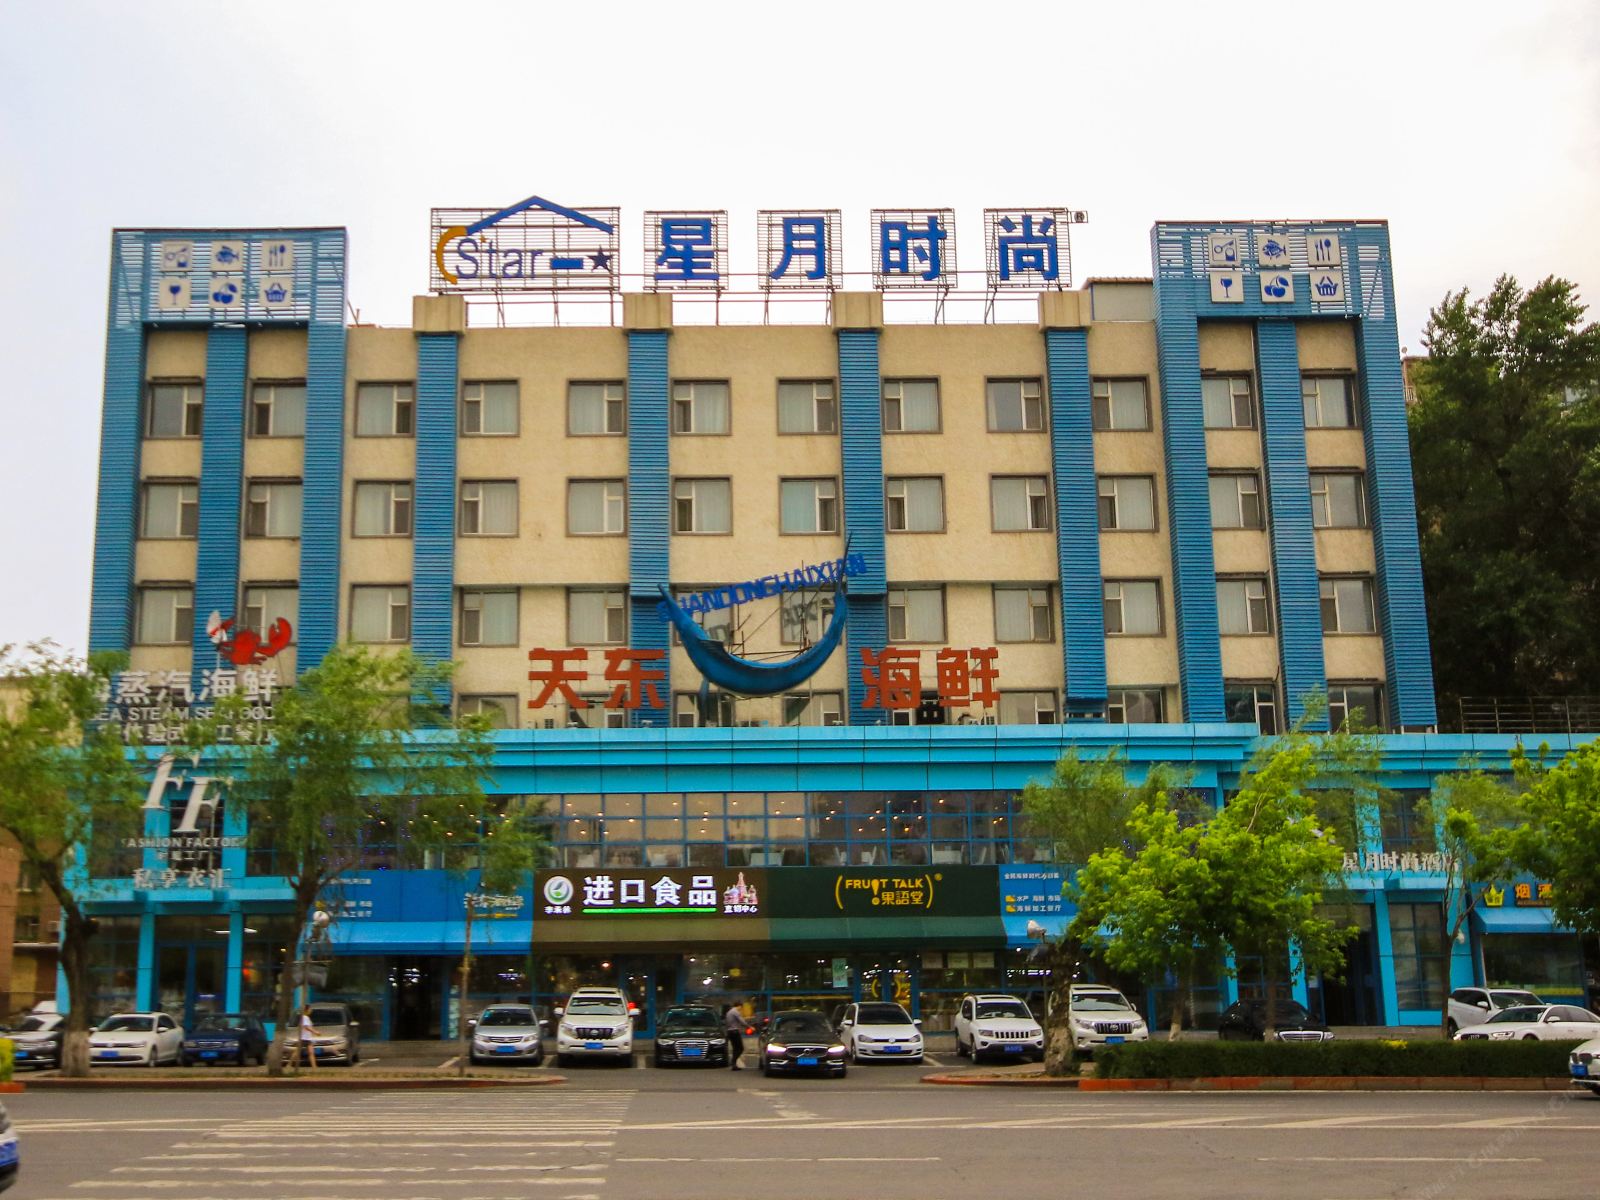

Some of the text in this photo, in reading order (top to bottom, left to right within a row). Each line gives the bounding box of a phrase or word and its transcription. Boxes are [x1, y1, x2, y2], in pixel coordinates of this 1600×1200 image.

[654, 214, 1061, 281] 星月时尚
[528, 647, 999, 709] 天东 海鲜
[583, 875, 717, 906] 进口食品
[892, 878, 924, 889] TALK
